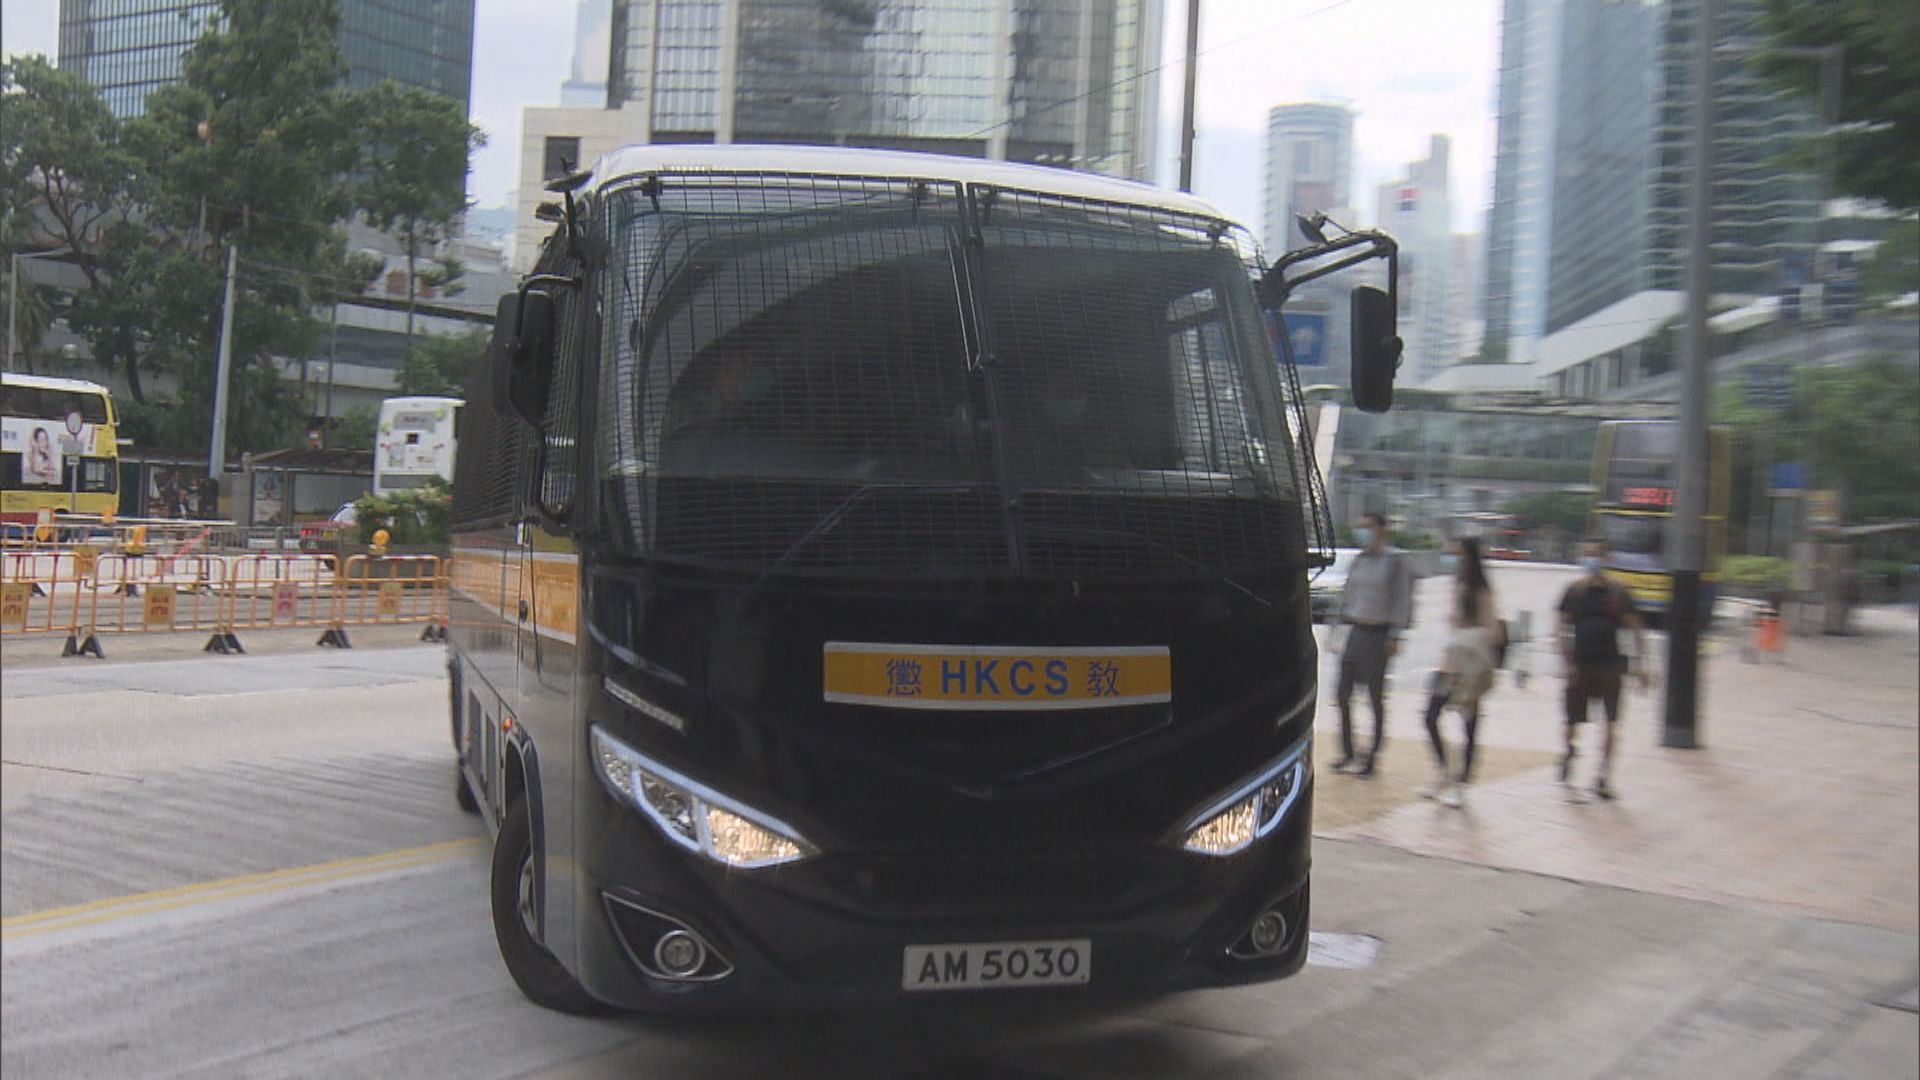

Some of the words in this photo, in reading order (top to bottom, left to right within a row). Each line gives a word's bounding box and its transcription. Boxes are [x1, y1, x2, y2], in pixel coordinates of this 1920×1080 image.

[886, 658, 921, 695] 懲
[941, 659, 1069, 695] HKCS
[918, 950, 968, 983] AM
[980, 947, 1080, 980] 5030
